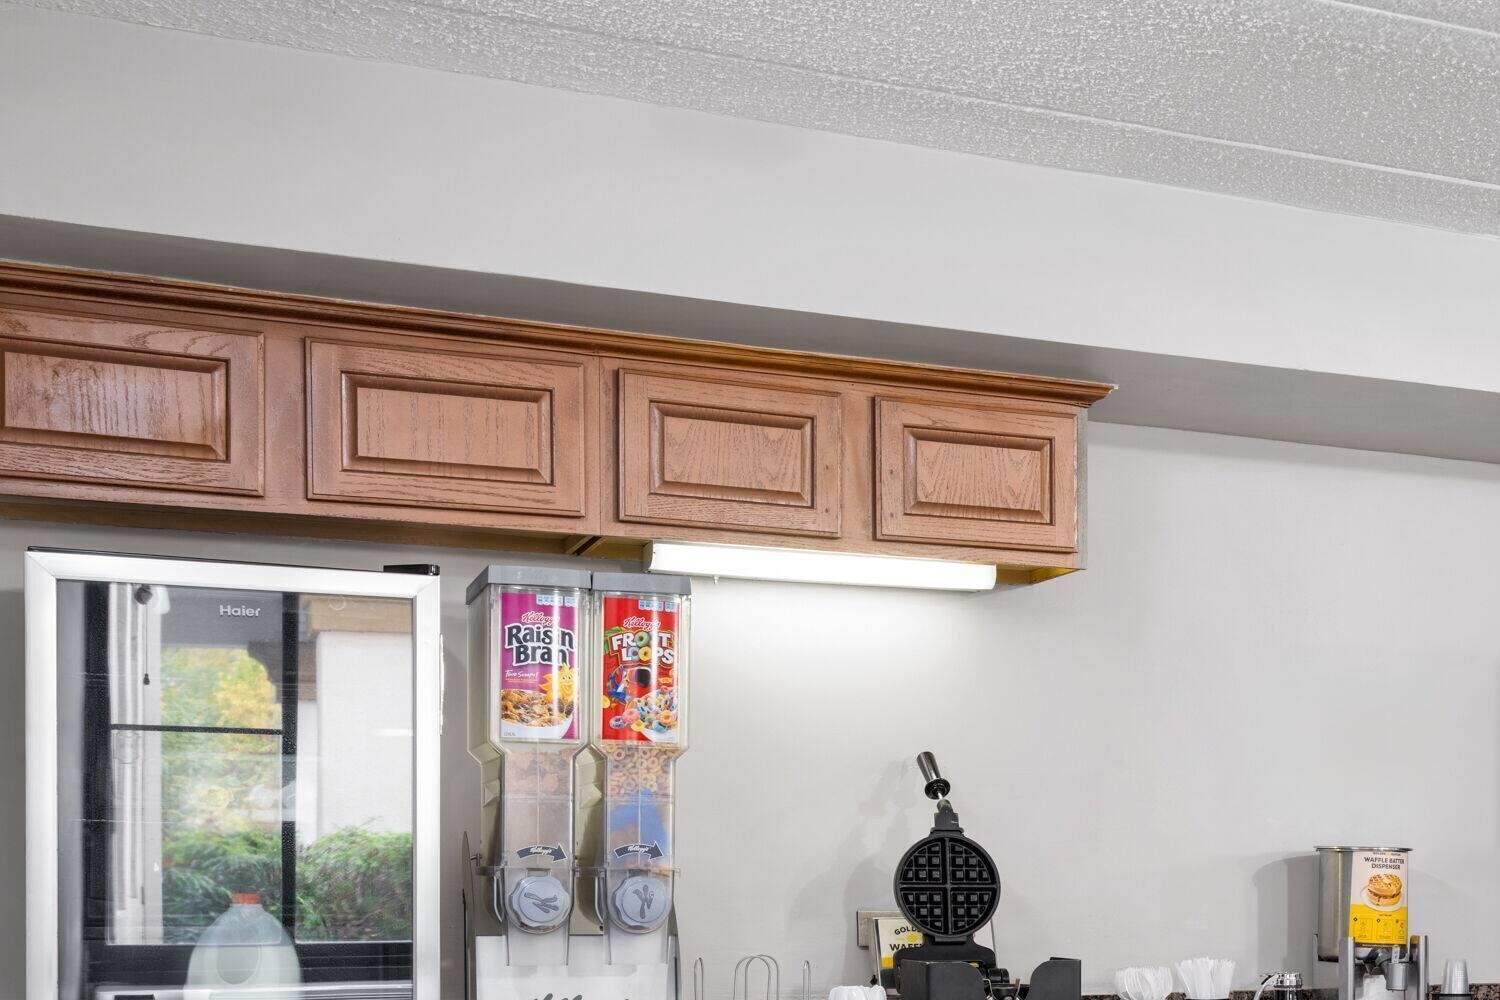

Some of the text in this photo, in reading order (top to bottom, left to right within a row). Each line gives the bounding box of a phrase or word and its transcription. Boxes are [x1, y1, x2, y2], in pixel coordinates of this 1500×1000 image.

[219, 605, 261, 617] Haier
[506, 624, 575, 651] Raisn
[610, 630, 672, 652] FROT
